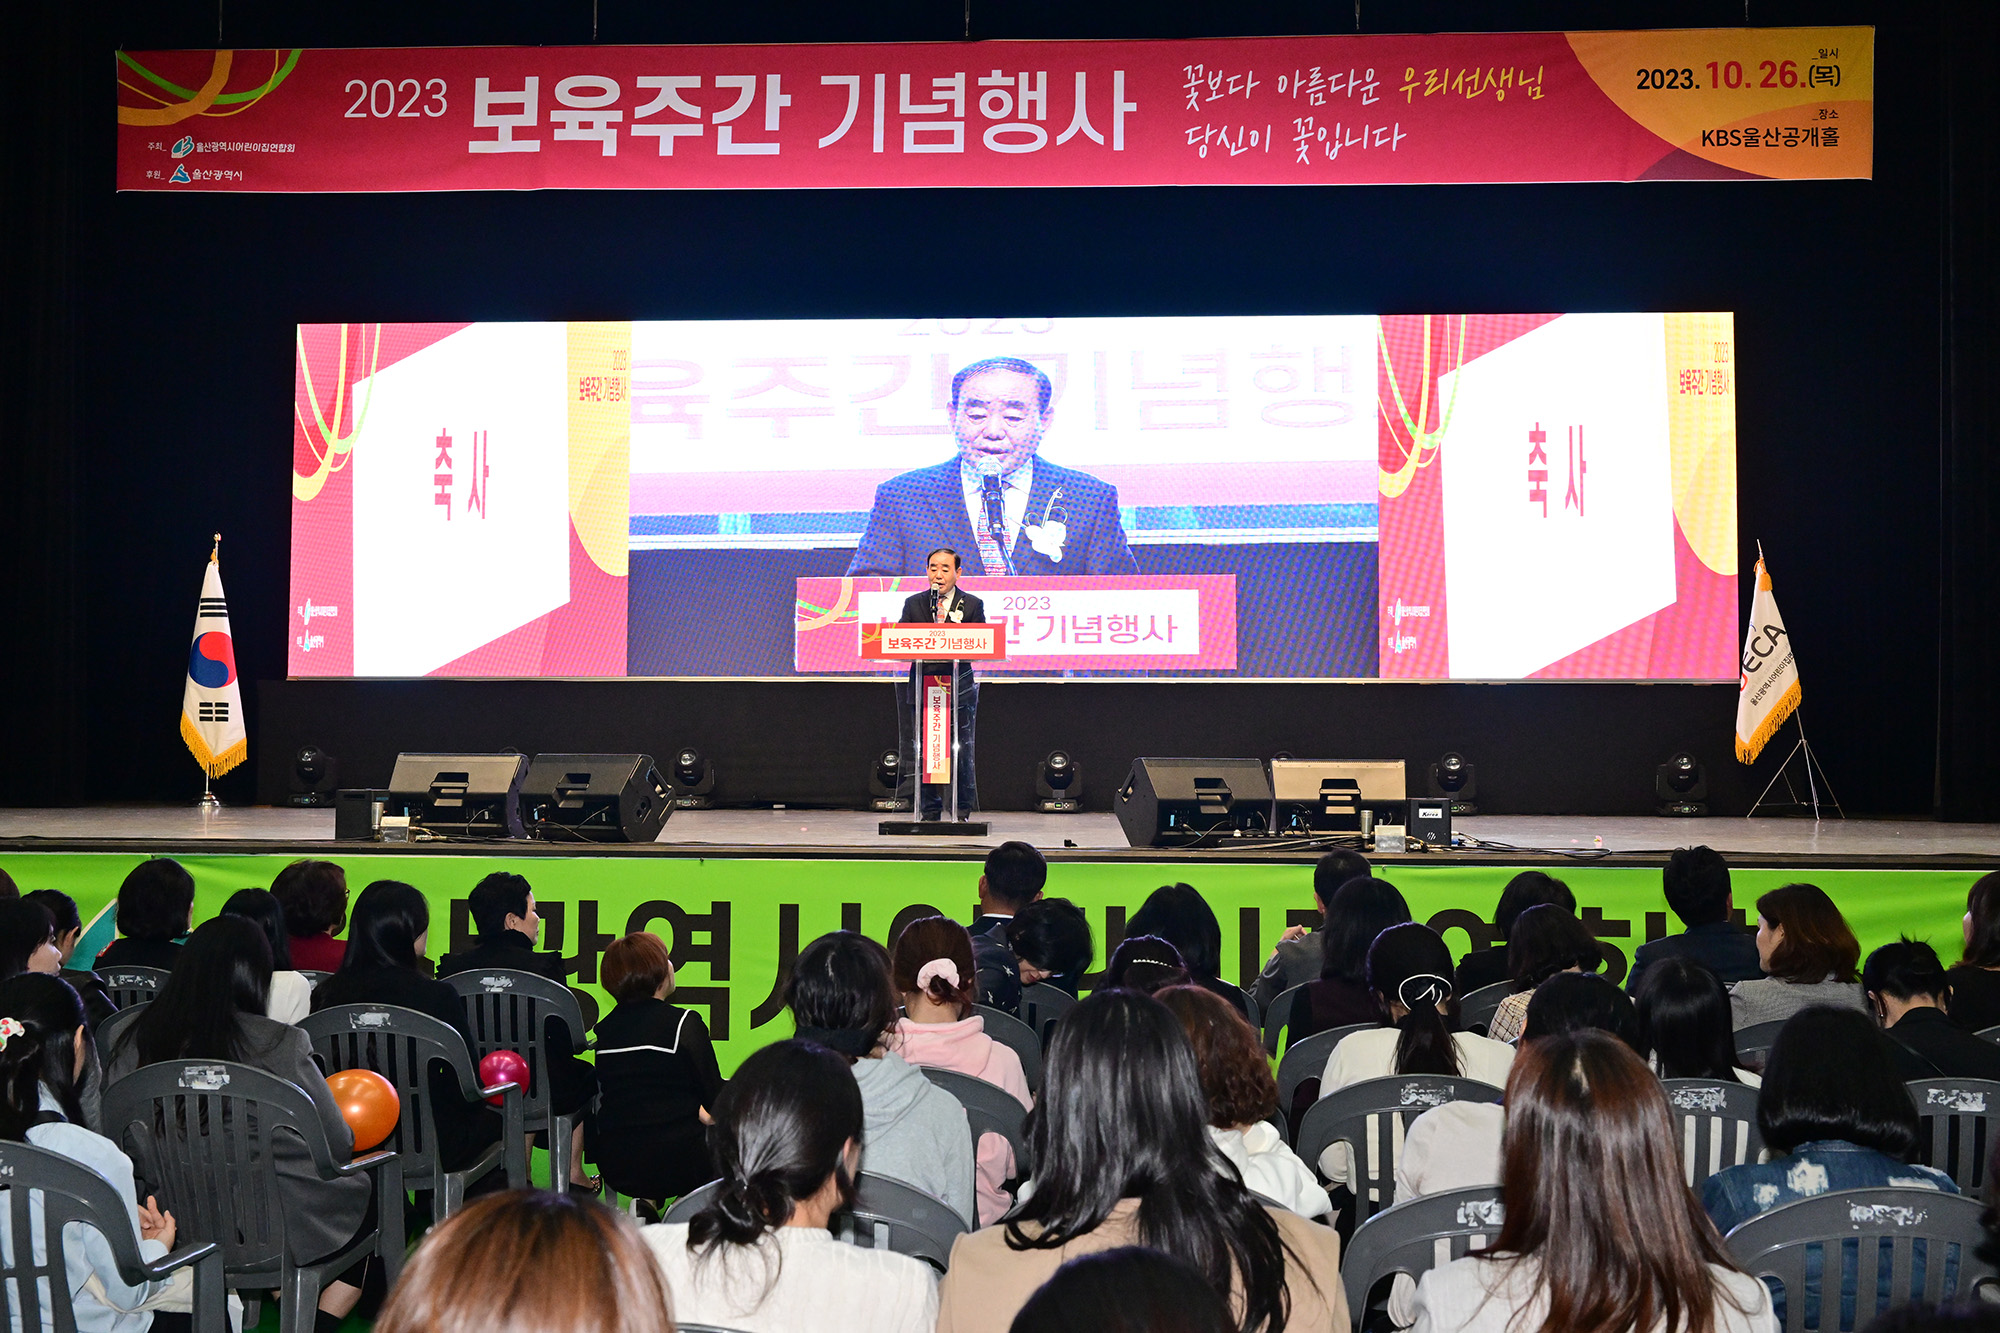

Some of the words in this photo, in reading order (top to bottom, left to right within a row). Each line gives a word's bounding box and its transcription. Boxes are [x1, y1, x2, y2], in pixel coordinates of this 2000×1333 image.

[1183, 63, 1261, 112] 꽃보다
[1277, 66, 1381, 106] 아름다운
[1398, 65, 1545, 104] 우리선생님
[1636, 68, 1701, 90] 2023.
[1705, 60, 1752, 89] 10.
[343, 78, 448, 119] 2023
[468, 74, 792, 158] 보육주간
[818, 69, 1138, 155] 기념행사
[196, 142, 296, 153] 울산광역시어린이집연합회
[1184, 122, 1272, 159] 당신이
[1292, 116, 1408, 165] 꽃입니다
[1701, 126, 1841, 148] KBS울산공개홀
[192, 168, 243, 181] 울산광역시
[613, 350, 627, 371] 2023
[1713, 341, 1729, 364] 2023
[579, 376, 602, 402] 보육주간
[604, 376, 627, 402] 기념행사
[1039, 346, 1377, 431] 기념행
[1679, 368, 1704, 396] 보육주간
[1704, 368, 1730, 396] 기념행사
[1003, 596, 1051, 611] 2023
[1036, 614, 1178, 644] 기념행사
[888, 637, 937, 650] 보육주간
[939, 637, 987, 650] 기념행사
[932, 696, 942, 732] 보육주간
[932, 734, 941, 770] 기념행사
